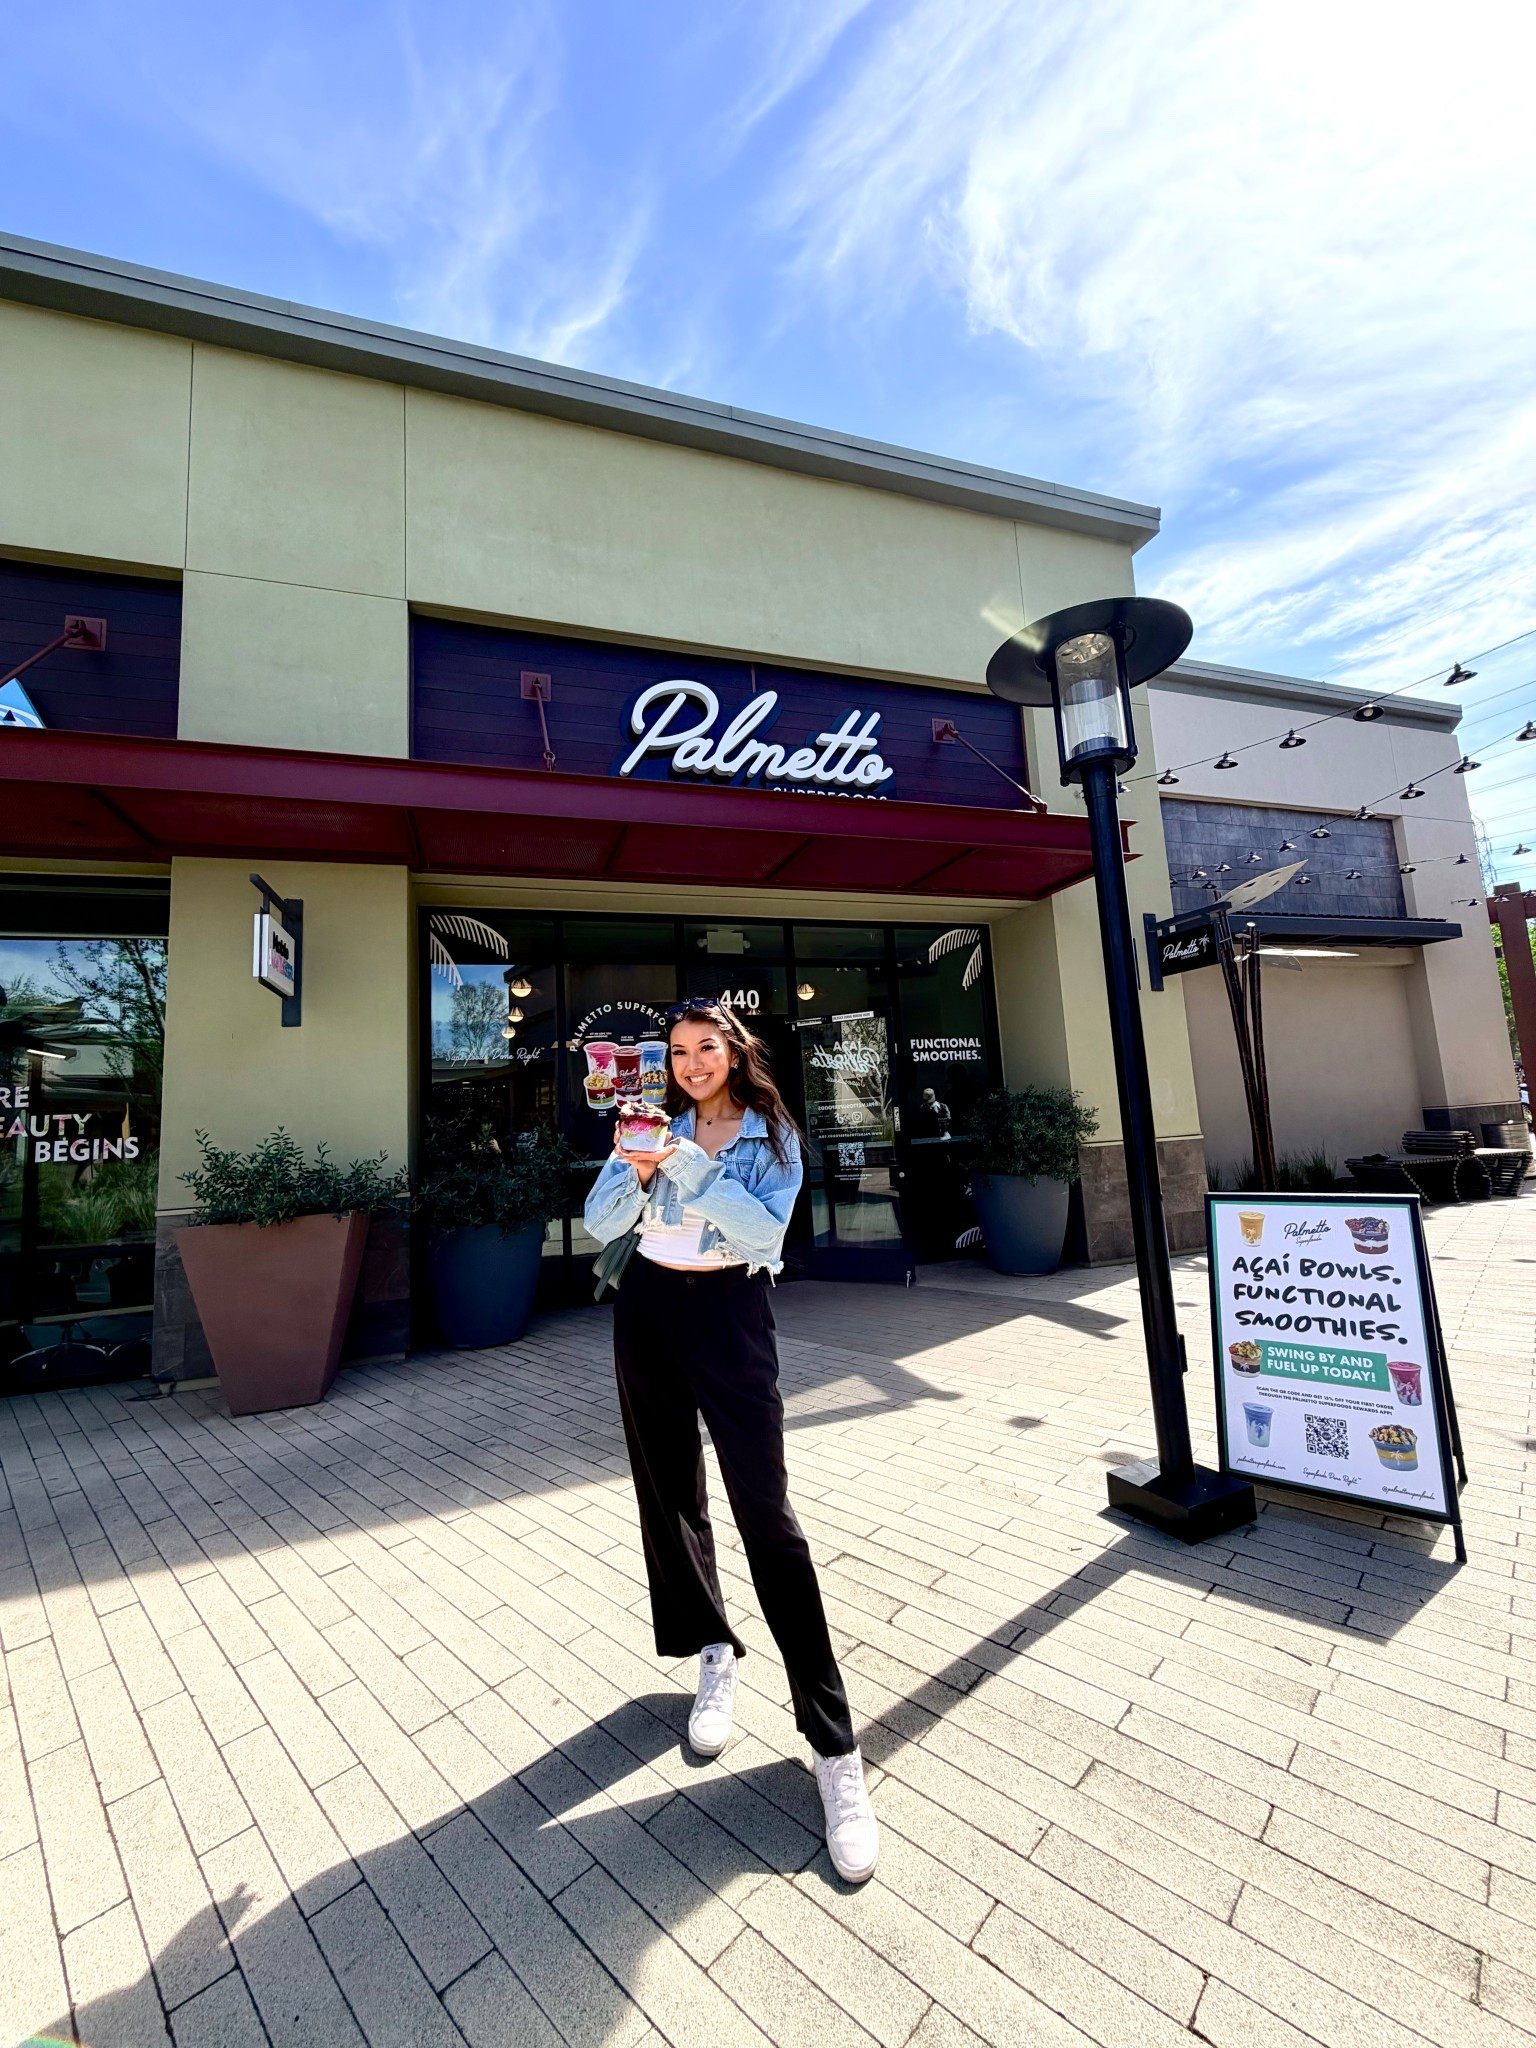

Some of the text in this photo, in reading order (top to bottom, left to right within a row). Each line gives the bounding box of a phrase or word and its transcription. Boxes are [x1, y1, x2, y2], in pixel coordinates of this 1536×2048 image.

[619, 679, 893, 787] Palmetto
[1162, 938, 1199, 962] Palmetto
[720, 990, 760, 1009] 440
[570, 1001, 666, 1052] PALMETTO SUPERFO
[491, 1048, 514, 1060] Done
[910, 1037, 981, 1050] FUNCTIONAL
[912, 1050, 982, 1062] SMOOTHIES.
[34, 1137, 140, 1163] BEGINS
[1284, 1219, 1332, 1240] Palmetto
[1232, 1253, 1402, 1284] AÇAÍ BOWLS.
[1234, 1284, 1402, 1313] FUNCTIONAL
[1235, 1310, 1408, 1344] SMOOTHIES.
[1268, 1346, 1374, 1368] SWING BY AND
[1267, 1359, 1376, 1382] FUEL UP TODAY!
[1318, 1401, 1352, 1409] SUPERFOODS
